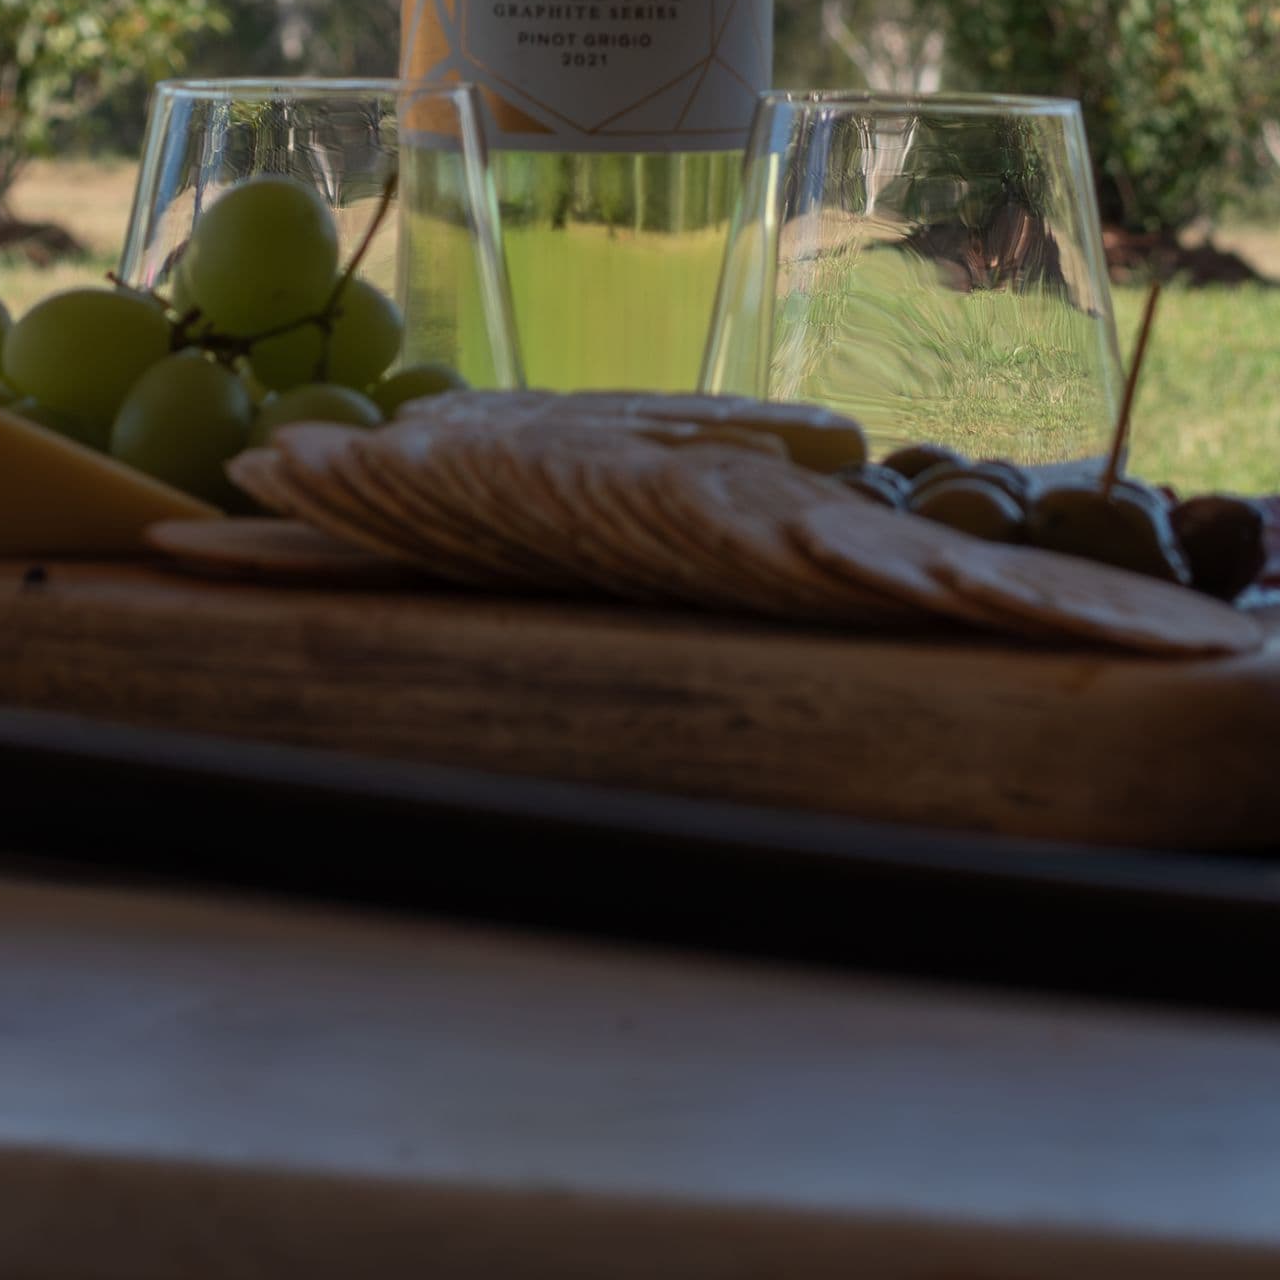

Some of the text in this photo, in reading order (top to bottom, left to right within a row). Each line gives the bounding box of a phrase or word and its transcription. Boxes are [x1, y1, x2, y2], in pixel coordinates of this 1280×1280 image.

[493, 4, 678, 20] GRAPHITE SERIES
[517, 31, 653, 48] PINOT GRIGIO
[560, 52, 609, 67] 2021
